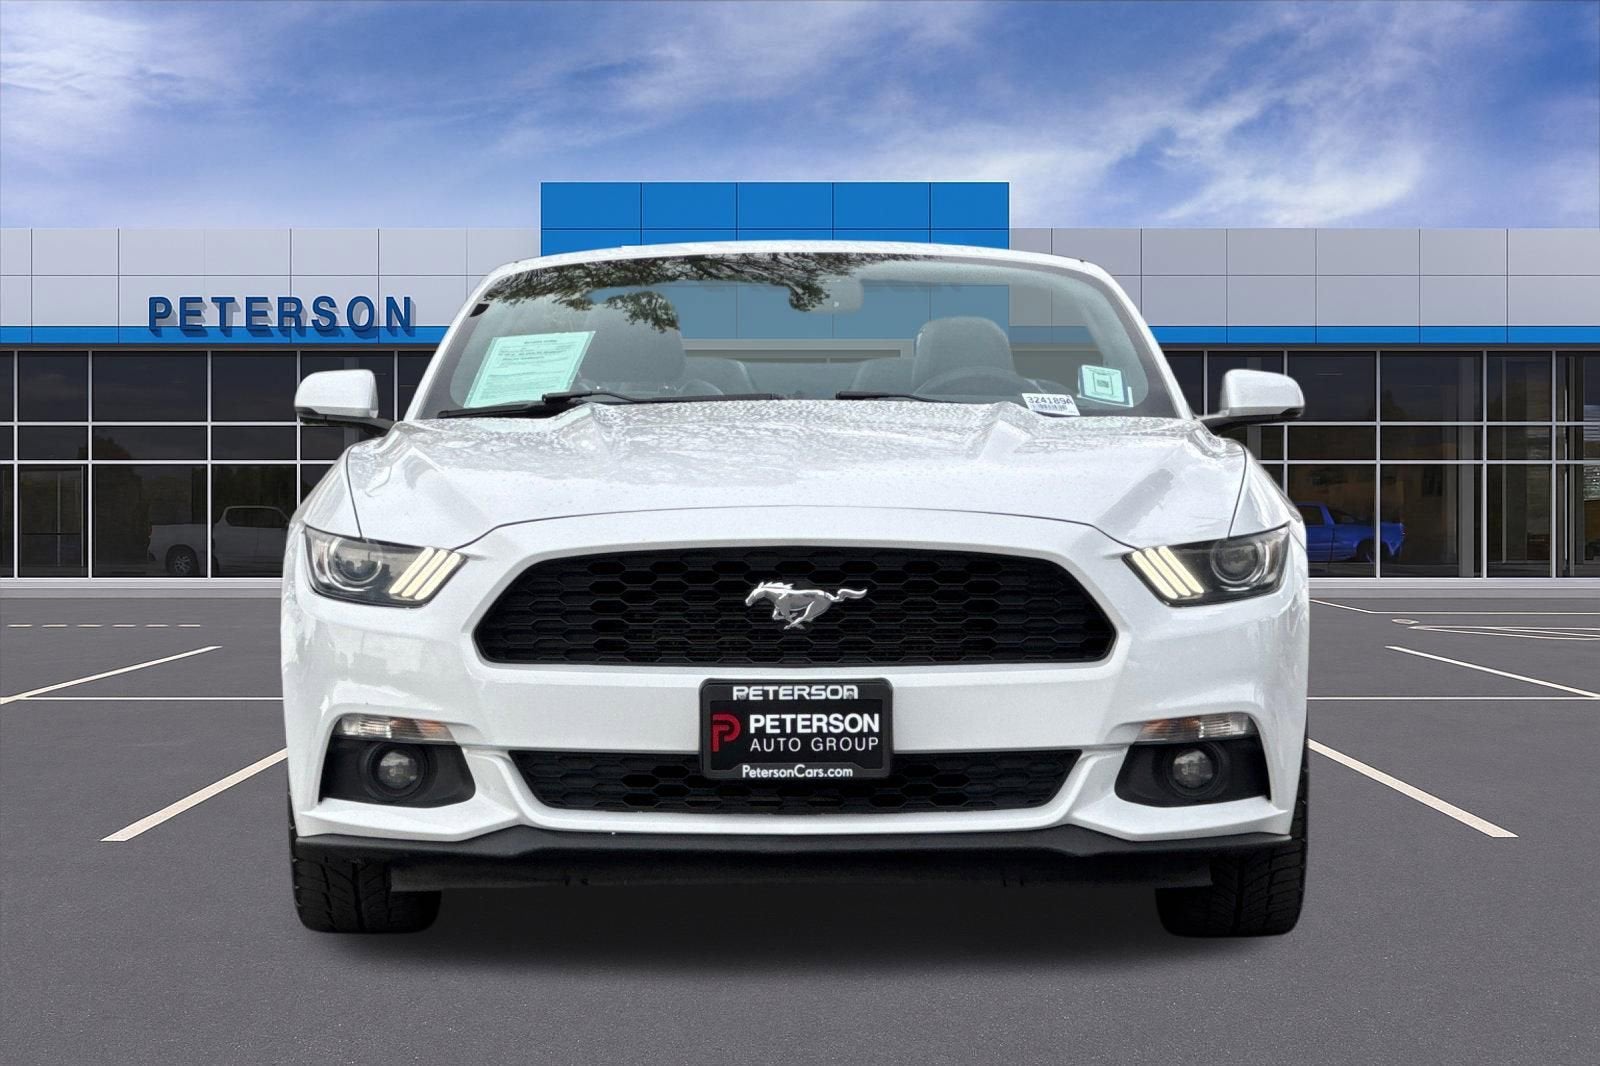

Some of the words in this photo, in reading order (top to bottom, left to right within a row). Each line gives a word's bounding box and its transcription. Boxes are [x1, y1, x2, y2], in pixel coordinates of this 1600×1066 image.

[148, 295, 411, 332] PETERSON
[732, 685, 859, 701] PETERSON
[749, 713, 880, 734] PETERSON
[750, 737, 802, 752] AUTO
[811, 736, 879, 752] GROUP
[742, 764, 853, 778] PetersonCars.com
